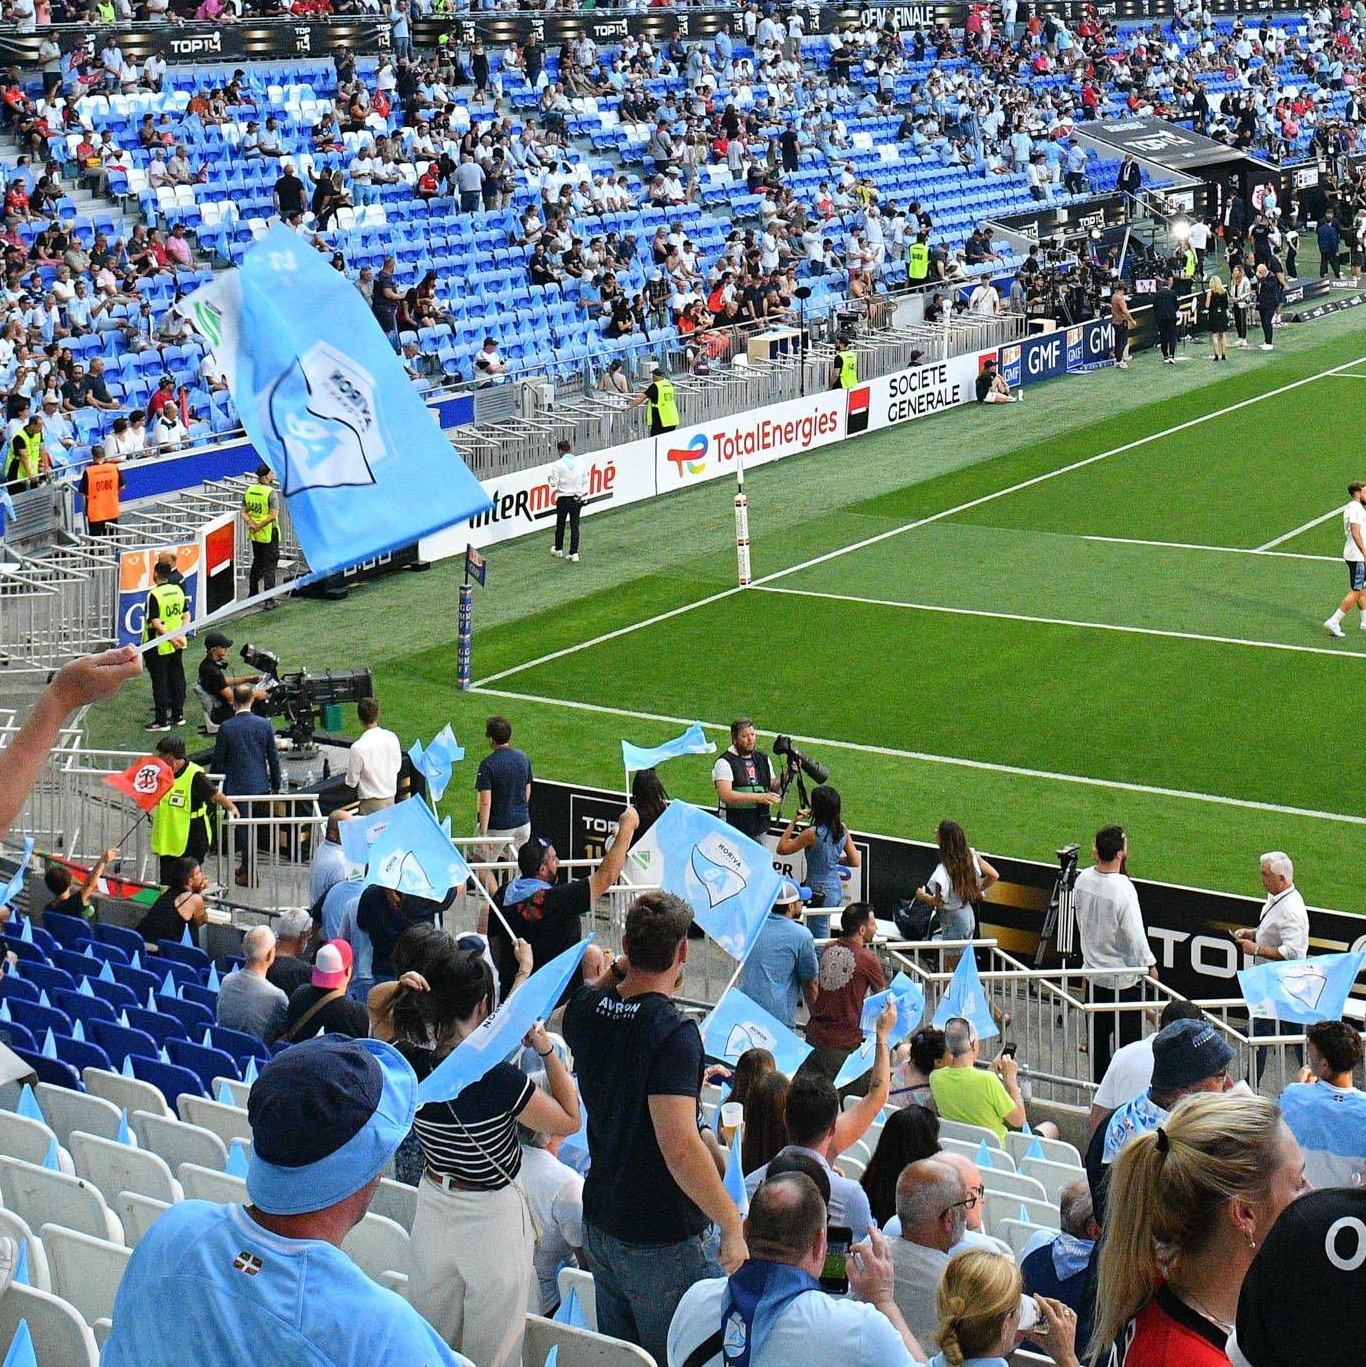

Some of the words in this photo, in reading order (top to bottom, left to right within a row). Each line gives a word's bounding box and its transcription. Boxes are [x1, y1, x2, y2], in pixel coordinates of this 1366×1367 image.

[1090, 327, 1115, 354] GM
[1028, 341, 1060, 374] GMF
[889, 365, 947, 398] SOCIETE
[887, 385, 960, 422] GENERALE
[713, 408, 837, 462] TotalEnergies
